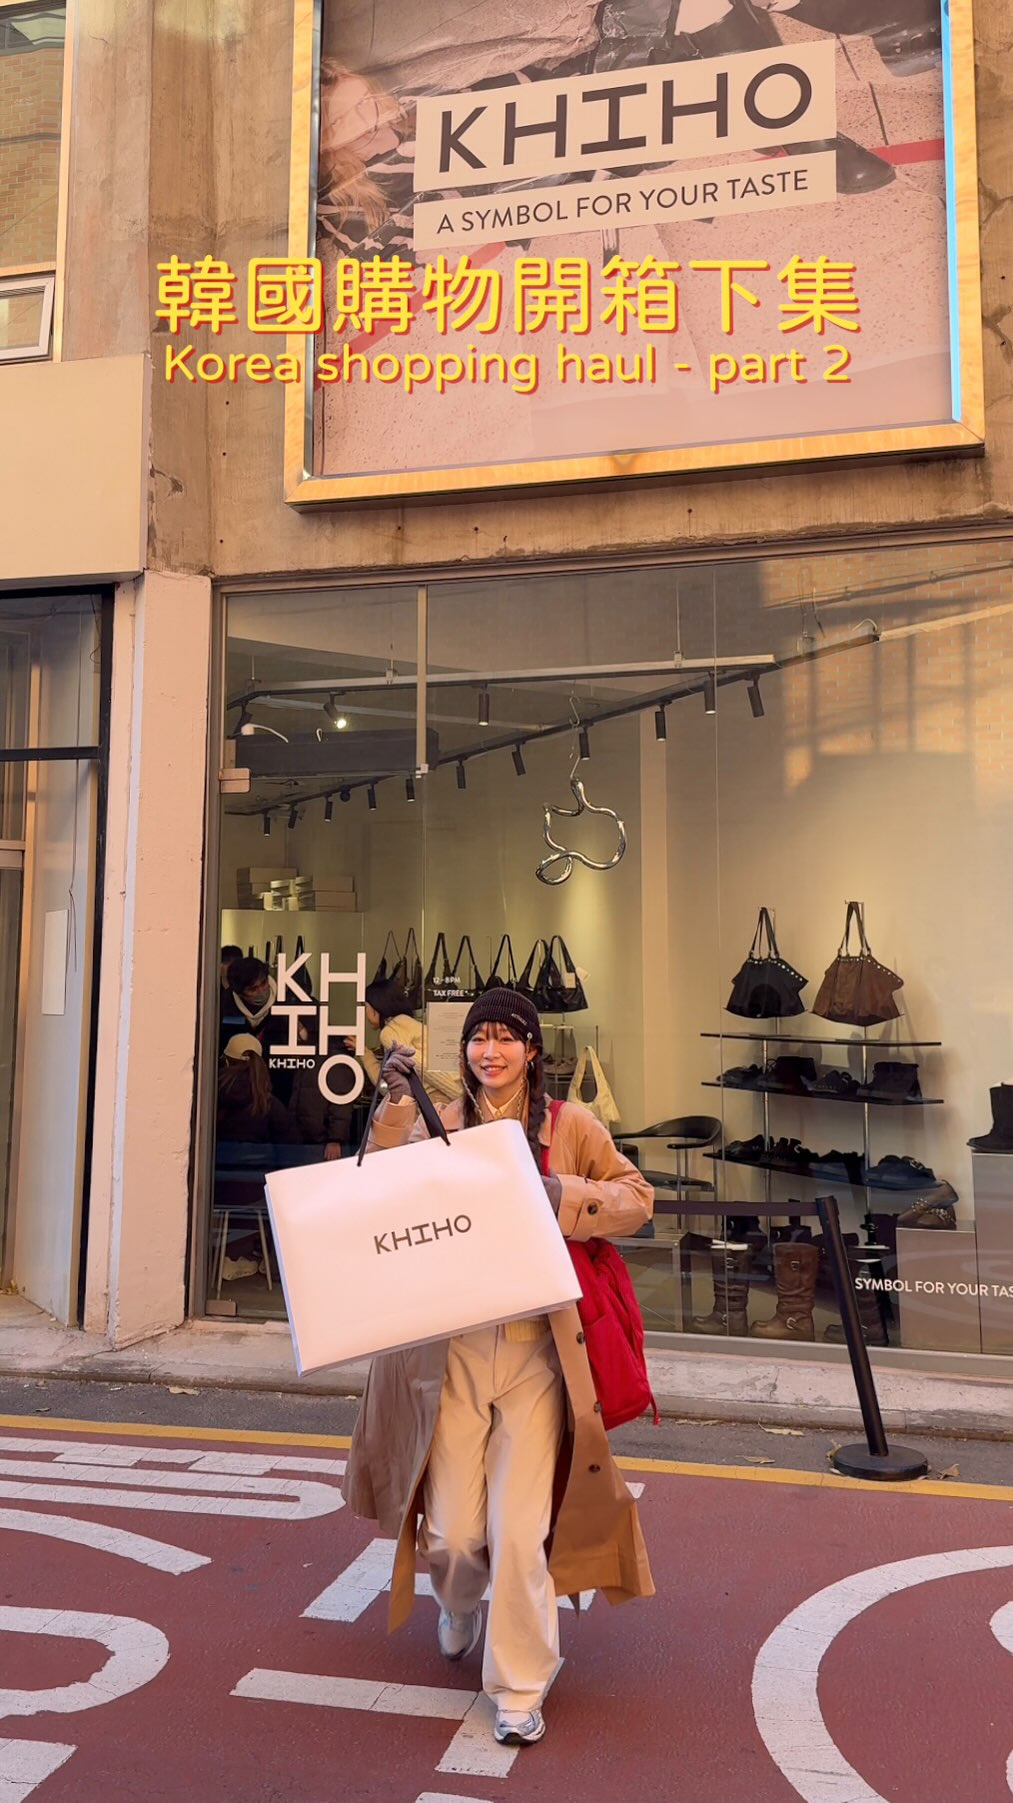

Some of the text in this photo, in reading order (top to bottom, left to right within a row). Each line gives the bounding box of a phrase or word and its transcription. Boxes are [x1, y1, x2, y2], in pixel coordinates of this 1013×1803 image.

[439, 63, 812, 173] KHIHO
[437, 169, 809, 234] A SYMBOL FOR YOUR TASTE
[269, 1058, 316, 1069] KHIHO
[374, 1214, 472, 1255] KHIHO
[855, 1277, 912, 1292] SYMBOL
[915, 1280, 945, 1294] FOR
[947, 1283, 989, 1297] YOUR
